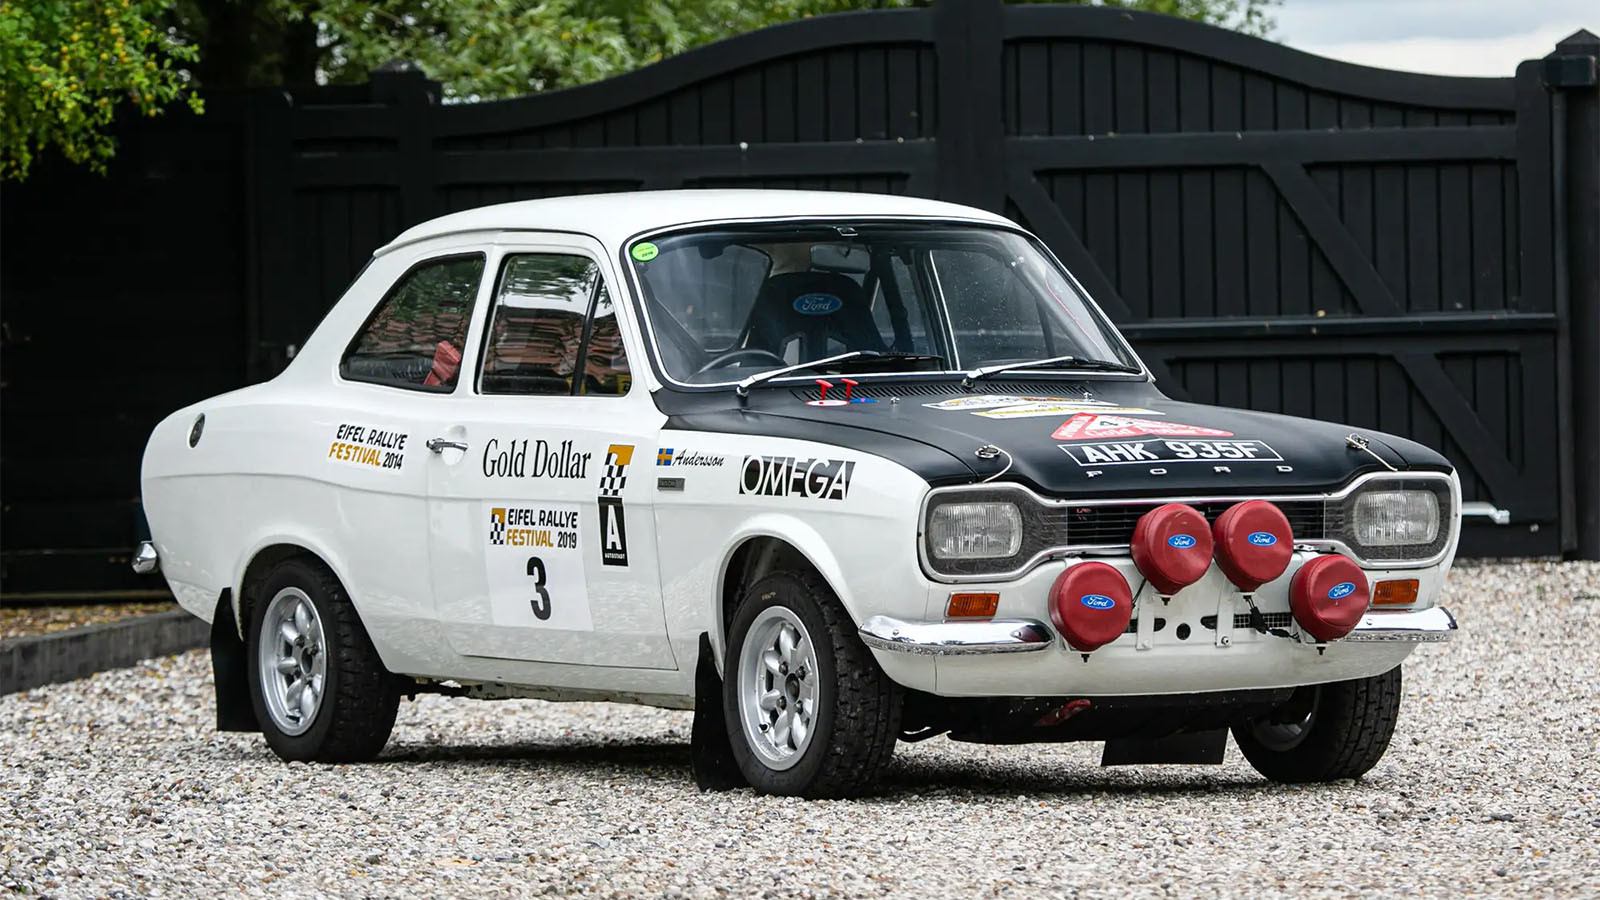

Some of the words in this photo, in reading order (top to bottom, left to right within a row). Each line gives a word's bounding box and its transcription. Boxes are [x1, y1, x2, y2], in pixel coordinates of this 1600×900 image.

[801, 296, 833, 311] Ford
[336, 423, 366, 443] EIFEL
[366, 429, 408, 450] RALLYE
[328, 442, 381, 467] FESTIVAL
[382, 452, 404, 470] 2014
[482, 438, 528, 478] Gold
[531, 439, 592, 479] Dollar
[672, 448, 725, 467] Andersson
[1081, 443, 1159, 463] AHK
[1165, 441, 1260, 459] 935F
[740, 455, 851, 501] OMEGA
[1086, 465, 1294, 478] FORD
[507, 508, 536, 526] EIFEL
[538, 510, 578, 529] RALLYE
[606, 504, 622, 550] A
[506, 529, 554, 548] FESTIVAL
[557, 531, 577, 549] 2019
[1173, 535, 1192, 546] Ford
[1254, 533, 1271, 544] Ford
[526, 556, 552, 621] 3
[1333, 584, 1350, 597] Ford
[1087, 596, 1109, 607] Ford
